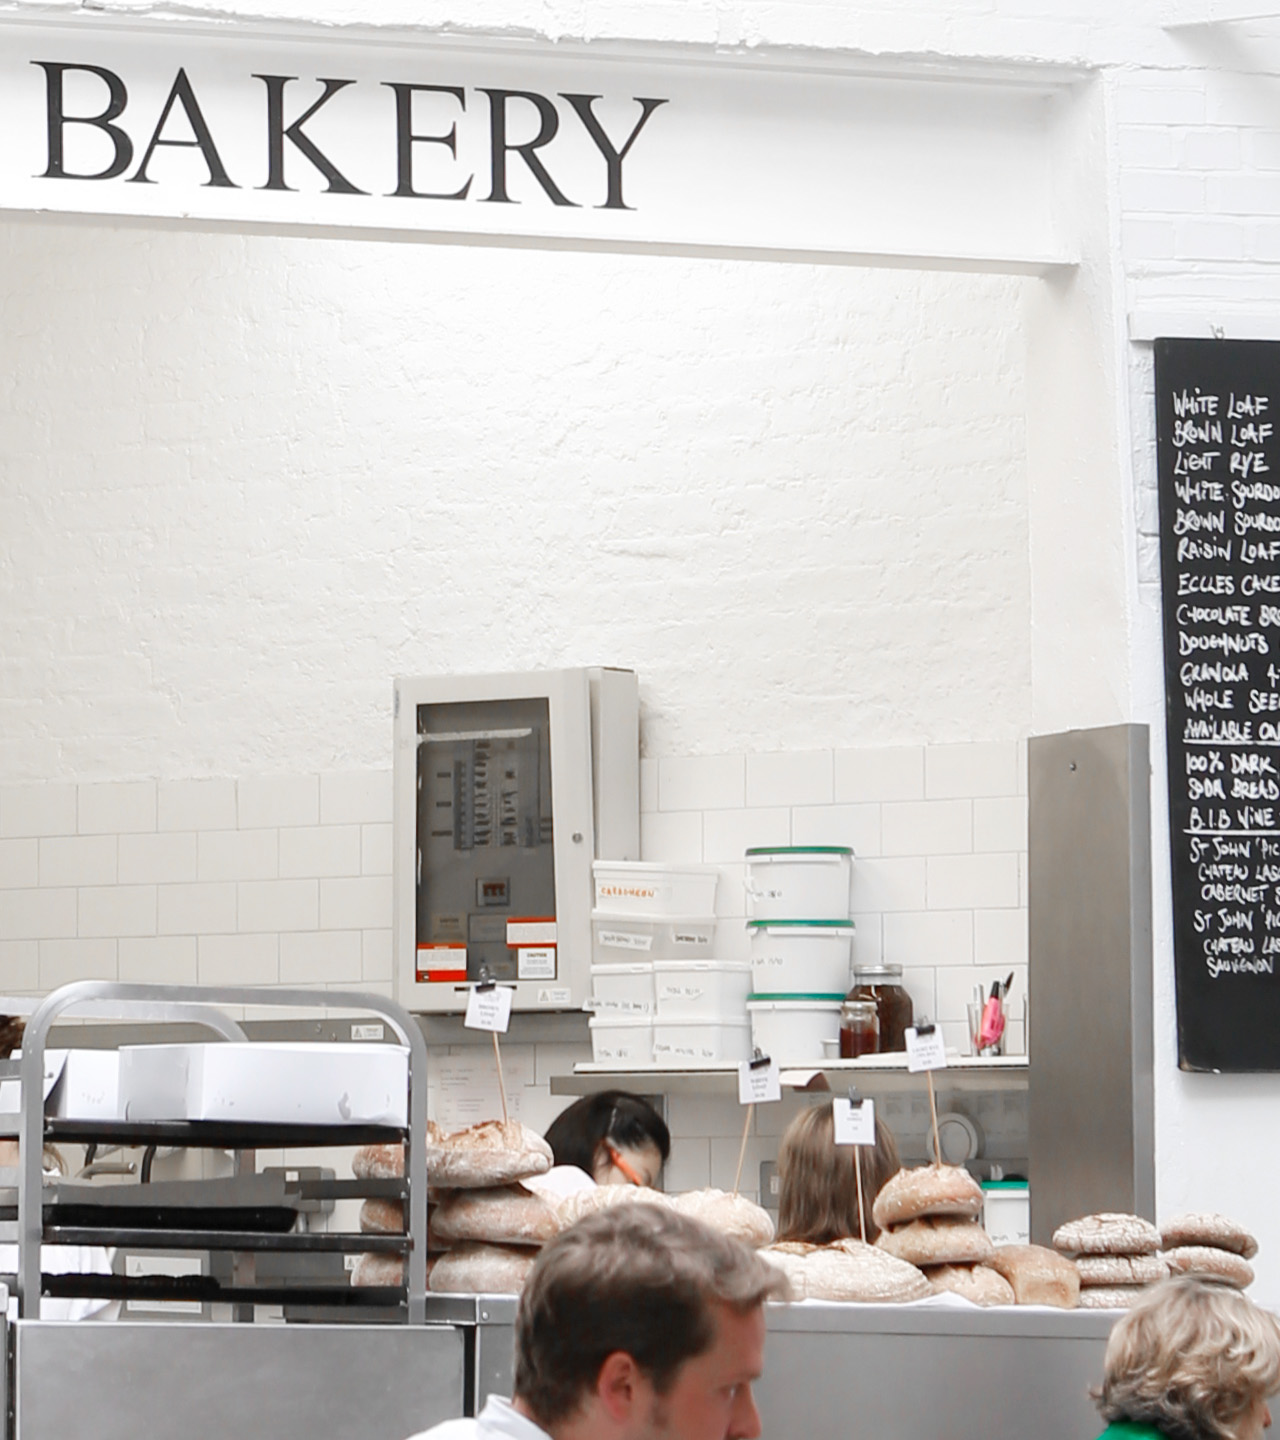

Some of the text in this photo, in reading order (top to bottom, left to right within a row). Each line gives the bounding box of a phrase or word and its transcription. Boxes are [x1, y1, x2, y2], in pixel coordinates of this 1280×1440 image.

[29, 60, 671, 211] BAKERY
[1172, 387, 1219, 418] WHITE
[1227, 392, 1269, 419] LOAF
[1172, 420, 1223, 448] BROWN
[1230, 423, 1273, 448] LOAF
[1174, 450, 1221, 475] LIGHT
[1229, 451, 1270, 479] RYE
[1174, 476, 1225, 505] WHITE
[1173, 508, 1225, 535] BROWN
[1177, 535, 1232, 563] RAISIN
[1177, 572, 1235, 596] ECCLES
[1176, 603, 1253, 626] CHOCOLATE
[1178, 630, 1270, 657] DOUGHNUTS
[1179, 661, 1250, 687] GRANOLA
[1184, 686, 1235, 713] WHOLE
[1183, 715, 1253, 741] AVAILABLE
[1230, 753, 1277, 775] DARK
[1188, 776, 1227, 801] SODA
[1230, 777, 1280, 801] BREAD
[1212, 837, 1251, 861] JOHN
[1198, 862, 1249, 882] CHATEAU
[1201, 884, 1269, 905] CABERNET
[1217, 907, 1254, 933] JOHN
